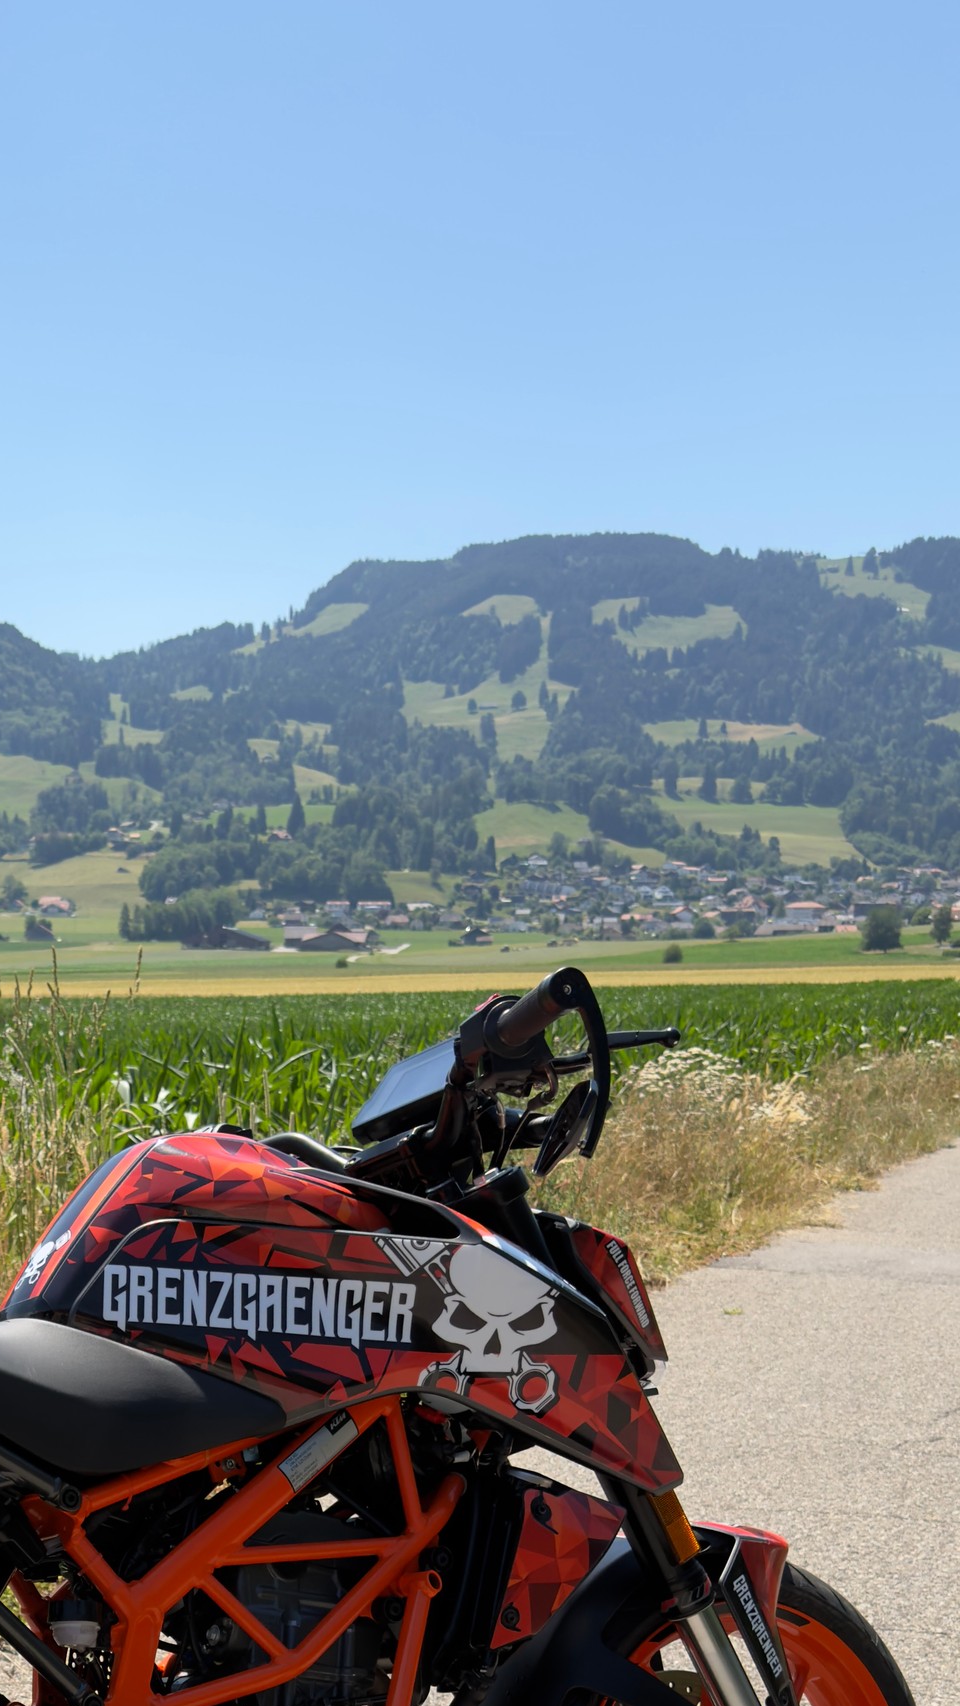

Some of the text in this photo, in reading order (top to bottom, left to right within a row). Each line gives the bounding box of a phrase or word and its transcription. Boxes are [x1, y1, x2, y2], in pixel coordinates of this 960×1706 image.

[606, 1239, 650, 1329] FULL FORCE FORWARD
[330, 1411, 347, 1430] KTM
